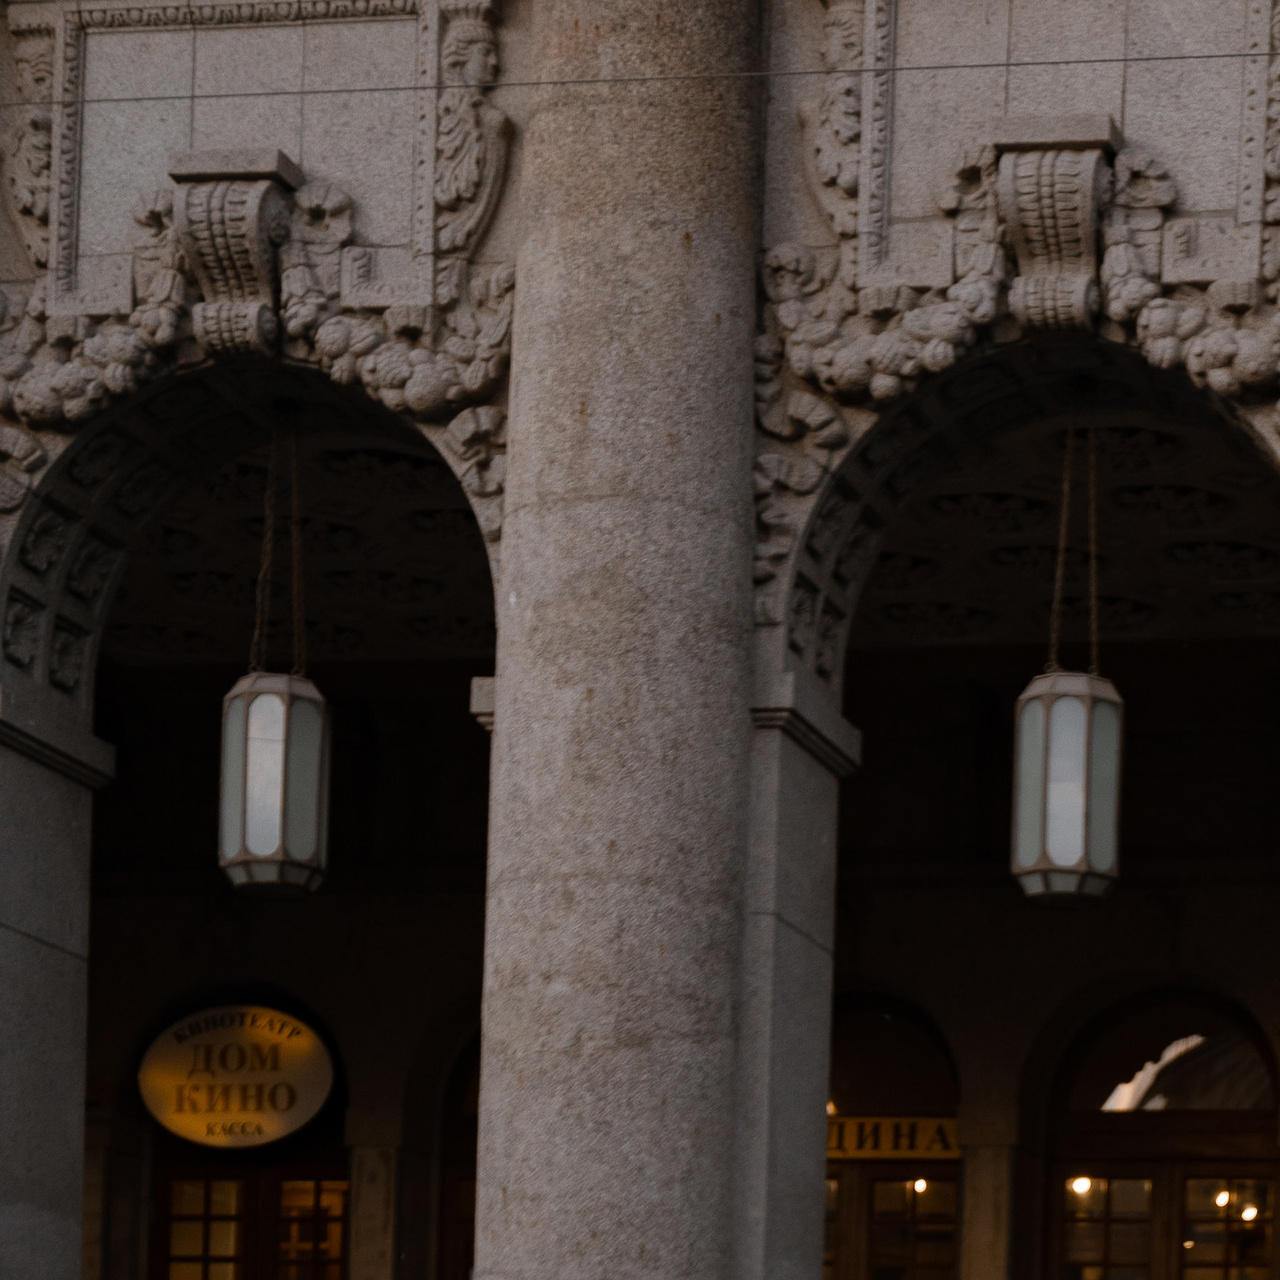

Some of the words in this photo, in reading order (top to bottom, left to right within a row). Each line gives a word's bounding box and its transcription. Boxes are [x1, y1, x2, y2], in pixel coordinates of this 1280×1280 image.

[174, 1011, 302, 1045] КИНОТЕАТР
[187, 1043, 282, 1079] ДОМ
[173, 1082, 296, 1113] КИНО
[206, 1121, 263, 1137] КАССА
